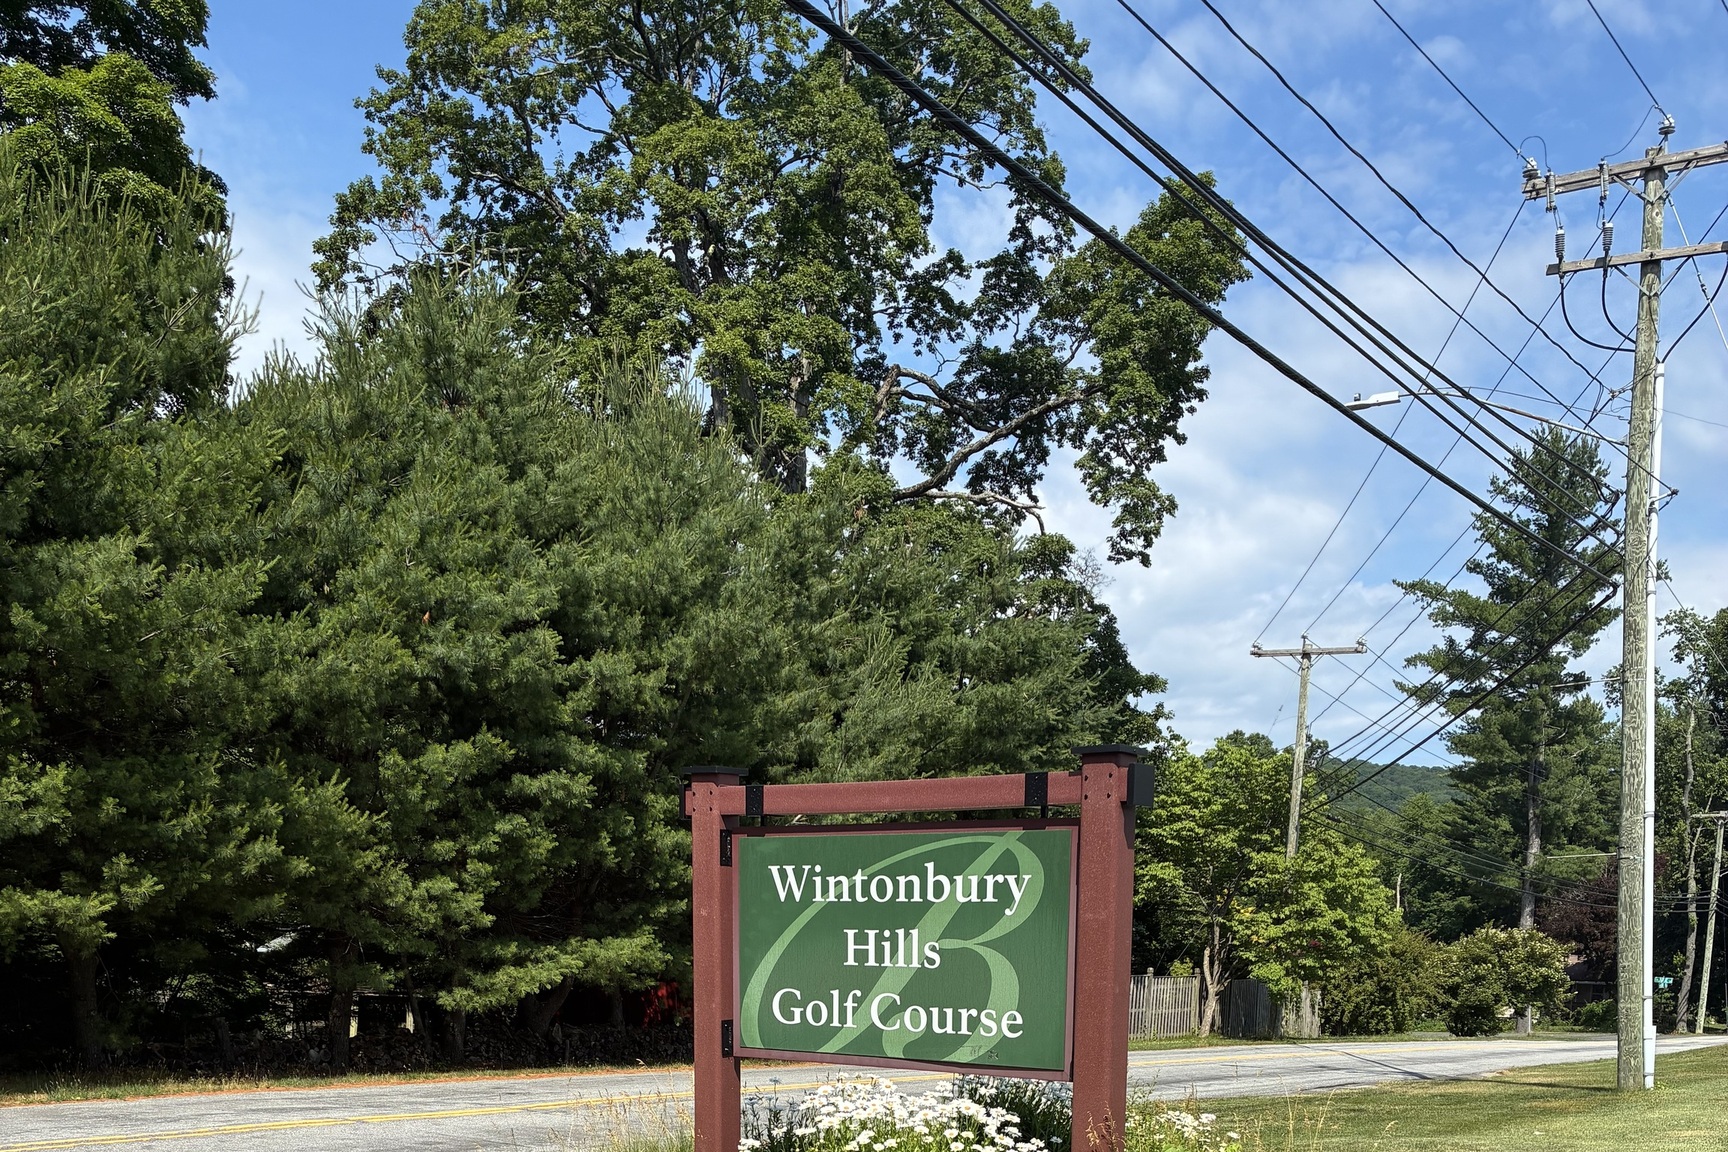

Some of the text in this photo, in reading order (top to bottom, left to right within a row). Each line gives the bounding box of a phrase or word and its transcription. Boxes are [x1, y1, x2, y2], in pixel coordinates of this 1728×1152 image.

[768, 861, 1032, 916] Wintonbury
[843, 928, 941, 969] Hills
[771, 988, 1024, 1038] Golf Course
